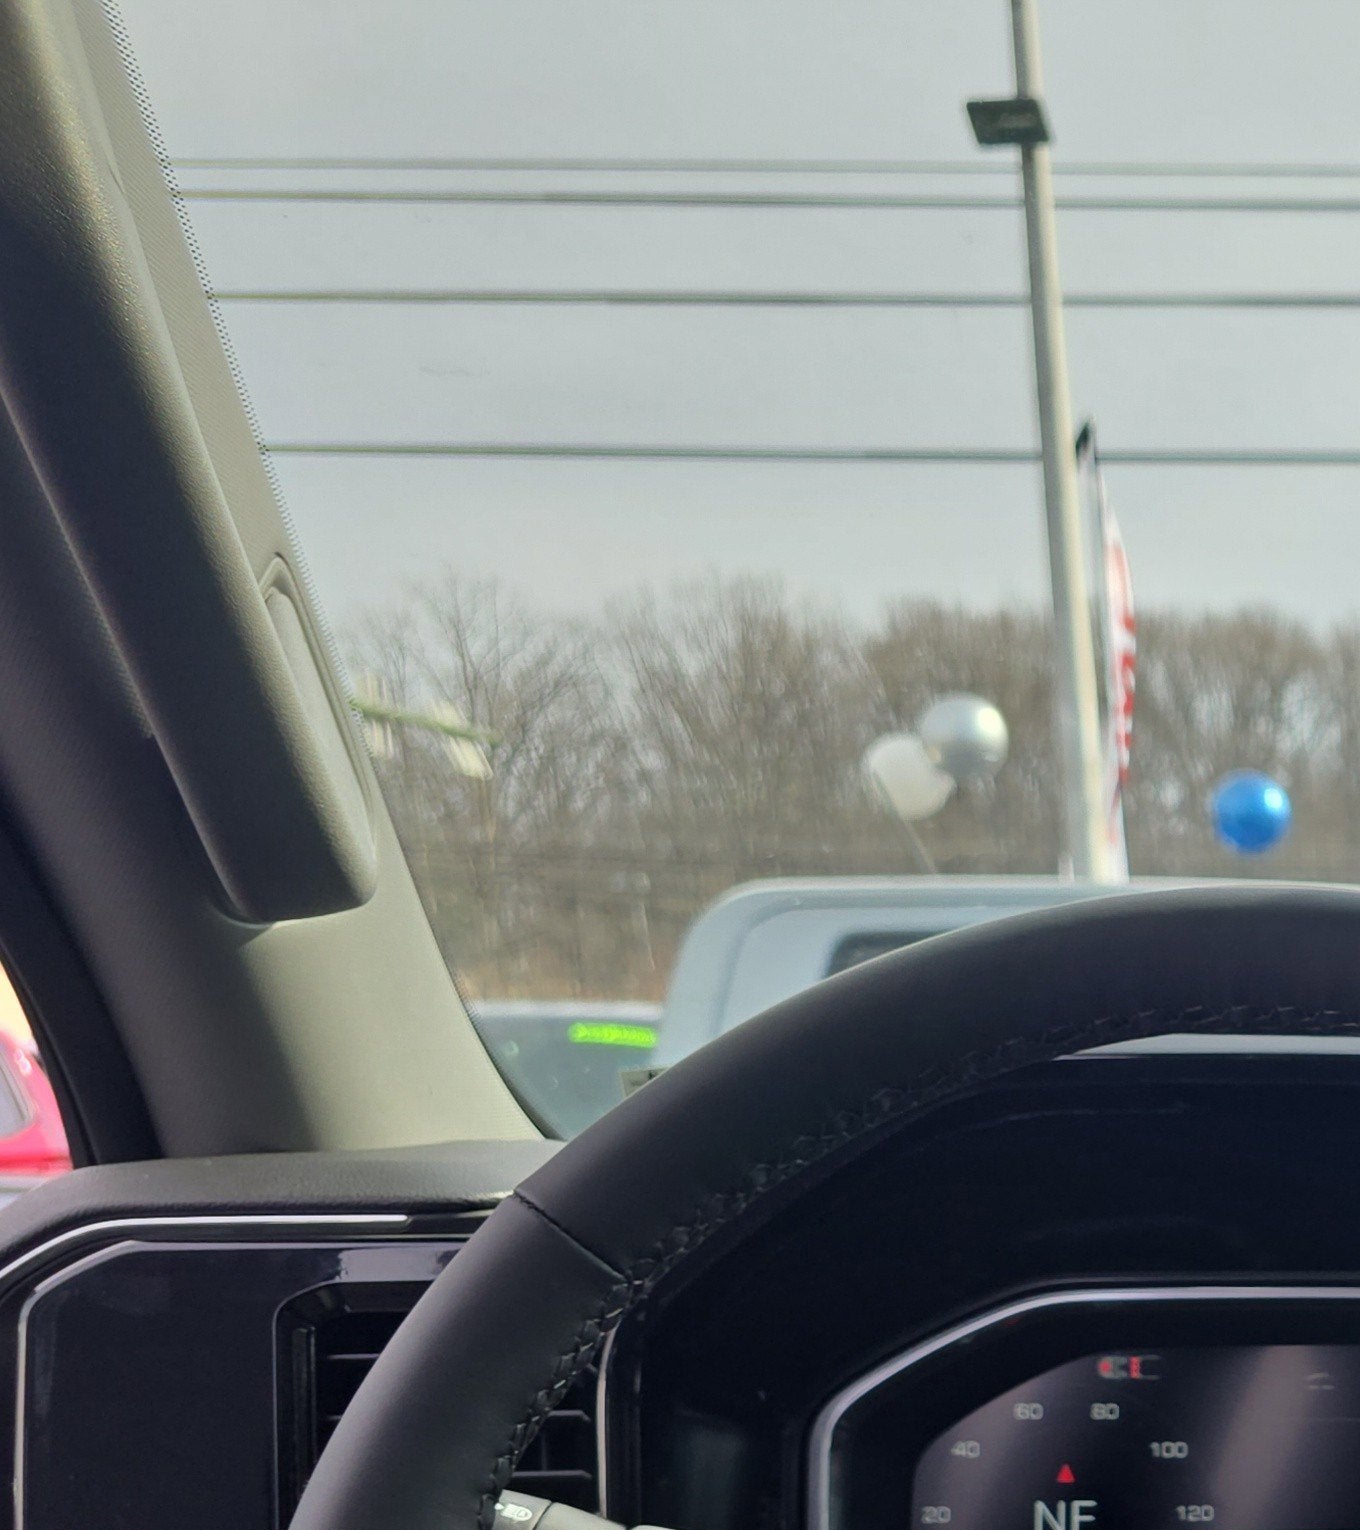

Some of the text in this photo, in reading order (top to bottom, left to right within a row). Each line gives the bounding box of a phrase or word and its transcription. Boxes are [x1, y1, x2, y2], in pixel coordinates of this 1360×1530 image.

[1013, 1403, 1044, 1420] 60
[1090, 1403, 1120, 1420] 80
[951, 1440, 981, 1459] 40
[1150, 1441, 1188, 1459] 100
[920, 1505, 951, 1524] 20
[1175, 1505, 1215, 1522] 120
